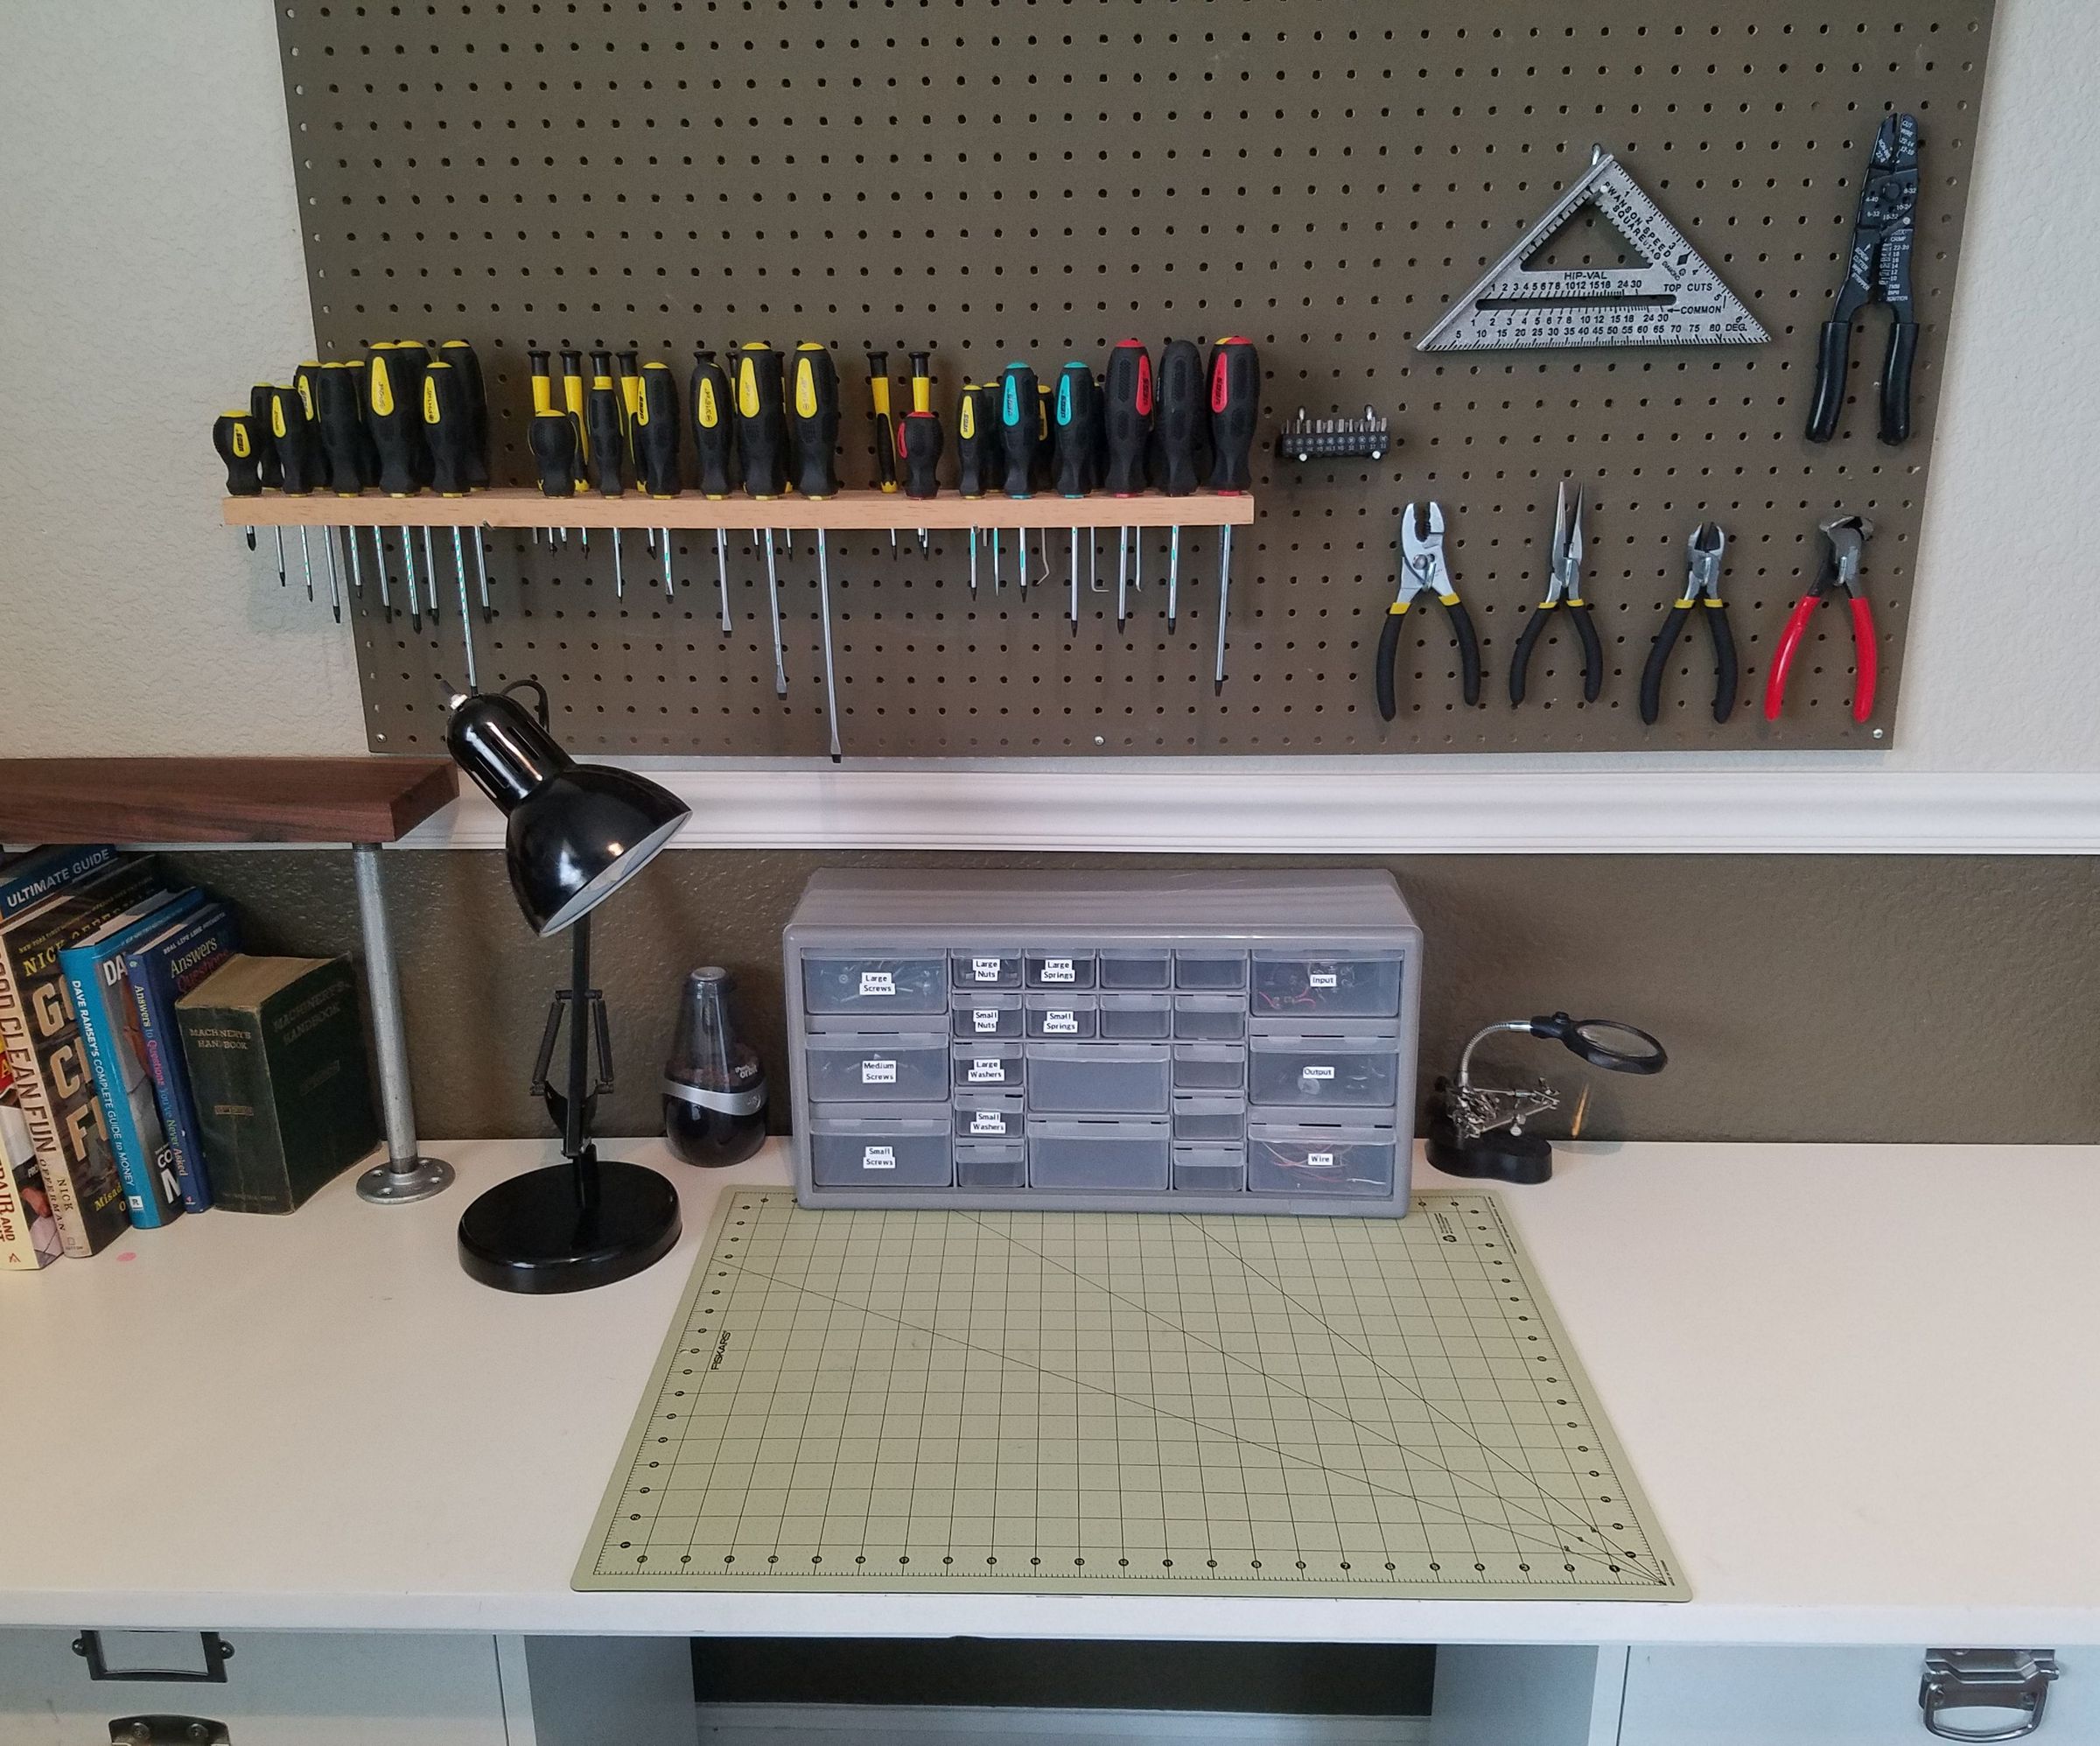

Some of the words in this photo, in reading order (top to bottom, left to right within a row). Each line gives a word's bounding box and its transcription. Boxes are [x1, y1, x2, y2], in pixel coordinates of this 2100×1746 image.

[1613, 205, 1646, 242] SQUARE
[1642, 227, 1671, 258] SPEED
[1540, 282, 1546, 291] 6
[1601, 280, 1611, 289] 18
[1564, 271, 1608, 281] HIP-VAL
[1663, 284, 1682, 292] TOP
[1687, 283, 1713, 291] CUTS
[1594, 315, 1605, 324] 12
[1657, 313, 1670, 322] 30
[1680, 305, 1722, 314] COMMON
[1497, 329, 1508, 338] 15
[1622, 326, 1633, 334] 55
[1710, 324, 1721, 333] 80
[1726, 324, 1747, 333] DEG.
[7, 867, 70, 908] ULTIMATE
[73, 848, 110, 874] GUIDE
[171, 937, 218, 979] Answers
[976, 961, 998, 970] Large
[1047, 961, 1070, 971] Large
[1043, 971, 1074, 980] Springs
[72, 980, 86, 1007] DAVE
[134, 985, 151, 1027] Answers
[80, 1009, 99, 1057] RAMSEY'S
[145, 1028, 154, 1039] to
[1046, 1022, 1075, 1031] Springs
[147, 1040, 165, 1086] Questions
[0, 1017, 41, 1099] CLEAN
[24, 1105, 57, 1153] FUN
[94, 1058, 114, 1108] COMPLETE
[158, 1088, 173, 1119] You've
[107, 1110, 122, 1139] GUIDE
[167, 1119, 180, 1147] Never
[116, 1142, 123, 1151] to
[118, 1152, 135, 1187] MONEY
[173, 1147, 189, 1176] Asked
[57, 1178, 74, 1211] NICK
[0, 1217, 15, 1241] AND
[710, 1331, 732, 1371] FISKARS
